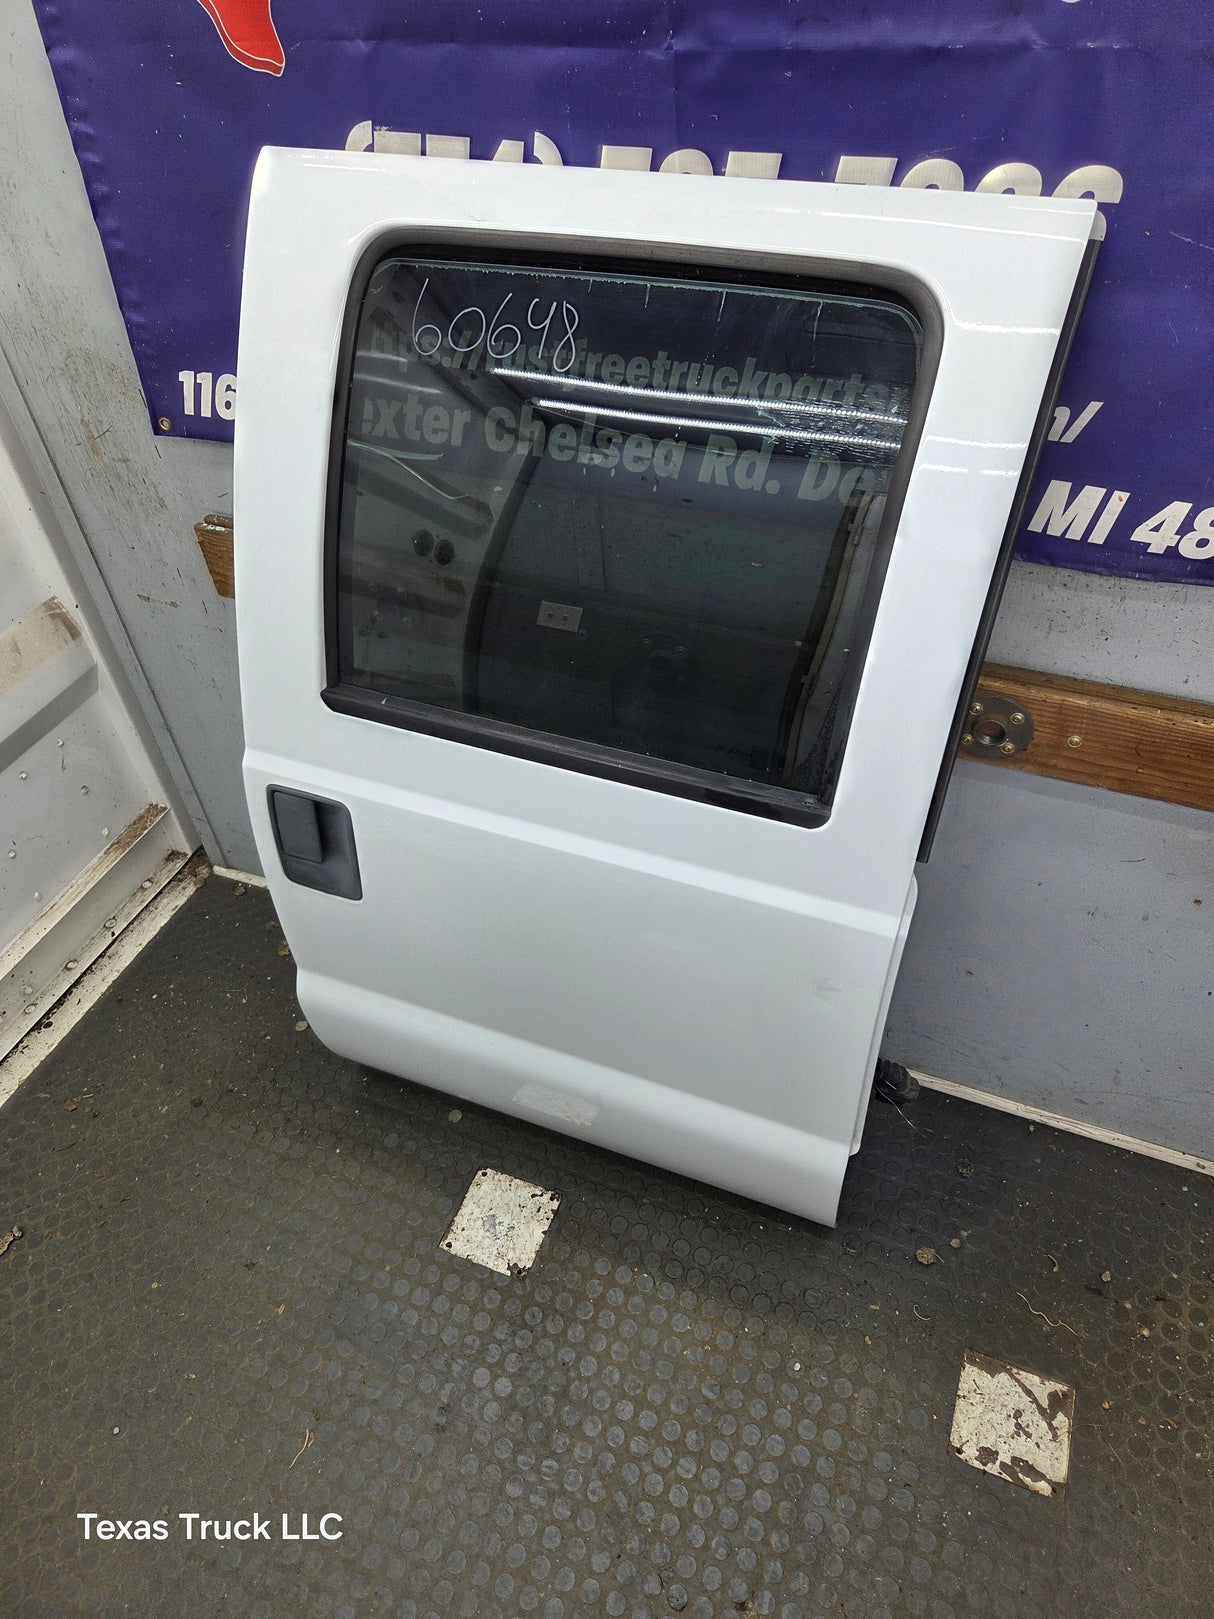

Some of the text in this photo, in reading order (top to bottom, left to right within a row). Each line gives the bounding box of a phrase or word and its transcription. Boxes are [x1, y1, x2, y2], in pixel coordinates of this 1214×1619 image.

[413, 278, 579, 372] 60648
[178, 370, 237, 421] 116
[485, 403, 687, 481] Chelsea
[698, 434, 780, 495] Rd.
[1027, 479, 1131, 545] MI
[1130, 500, 1214, 560] 48
